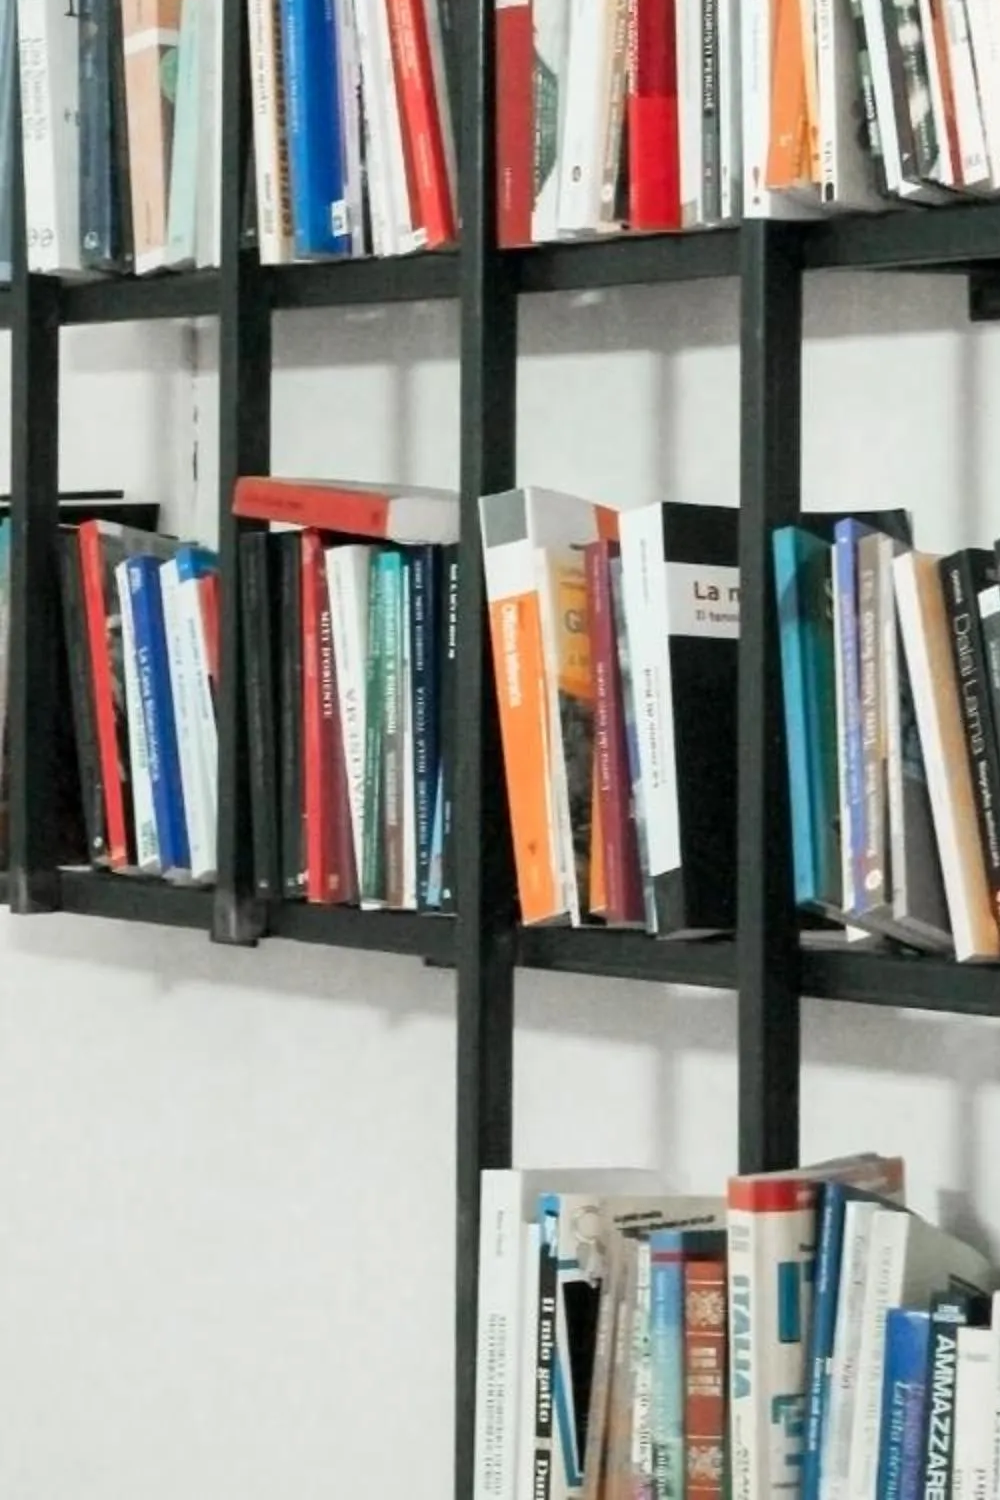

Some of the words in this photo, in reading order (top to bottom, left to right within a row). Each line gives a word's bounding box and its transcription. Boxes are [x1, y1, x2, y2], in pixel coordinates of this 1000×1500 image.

[694, 581, 720, 601] La
[954, 612, 977, 677] Dalai
[963, 680, 986, 755] Lama
[541, 1297, 554, 1312] Il
[539, 1319, 553, 1361] mio
[733, 1274, 752, 1399] ITALIA
[536, 1367, 551, 1423] gatto
[924, 1333, 957, 1500] AMMAZZARE
